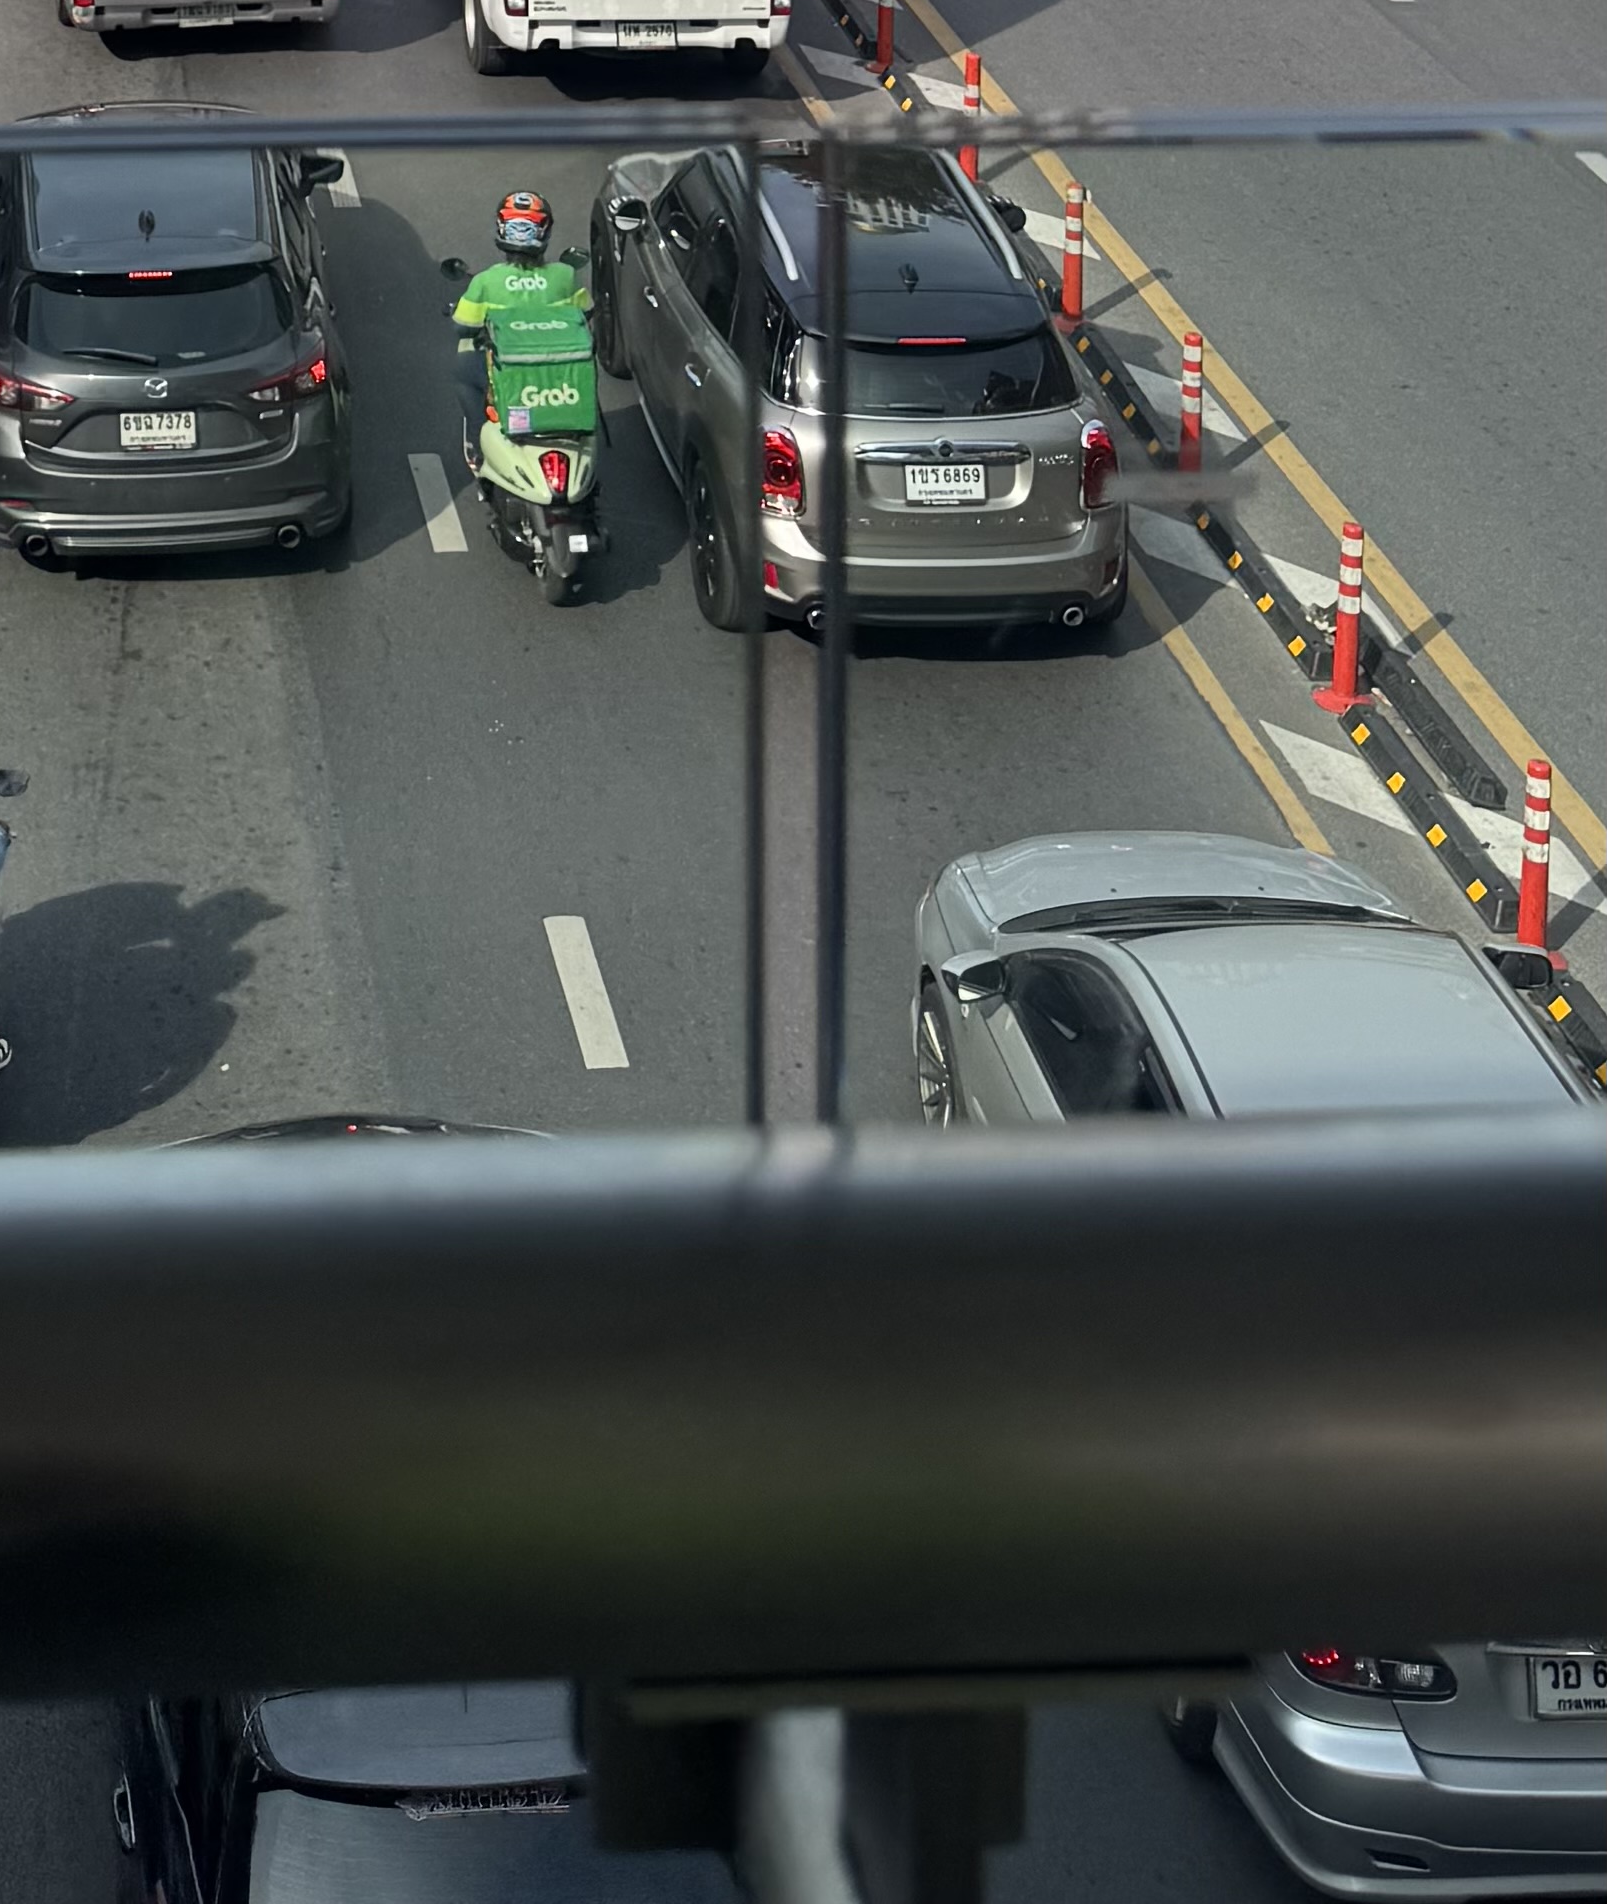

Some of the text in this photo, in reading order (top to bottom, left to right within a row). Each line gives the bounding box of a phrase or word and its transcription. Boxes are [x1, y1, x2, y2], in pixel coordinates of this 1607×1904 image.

[505, 272, 547, 291] Grab
[509, 320, 569, 330] Grab
[521, 383, 580, 408] Grab
[156, 413, 192, 429] 7378
[943, 467, 980, 483] 6869
[1541, 1659, 1607, 1690] วอ 6
